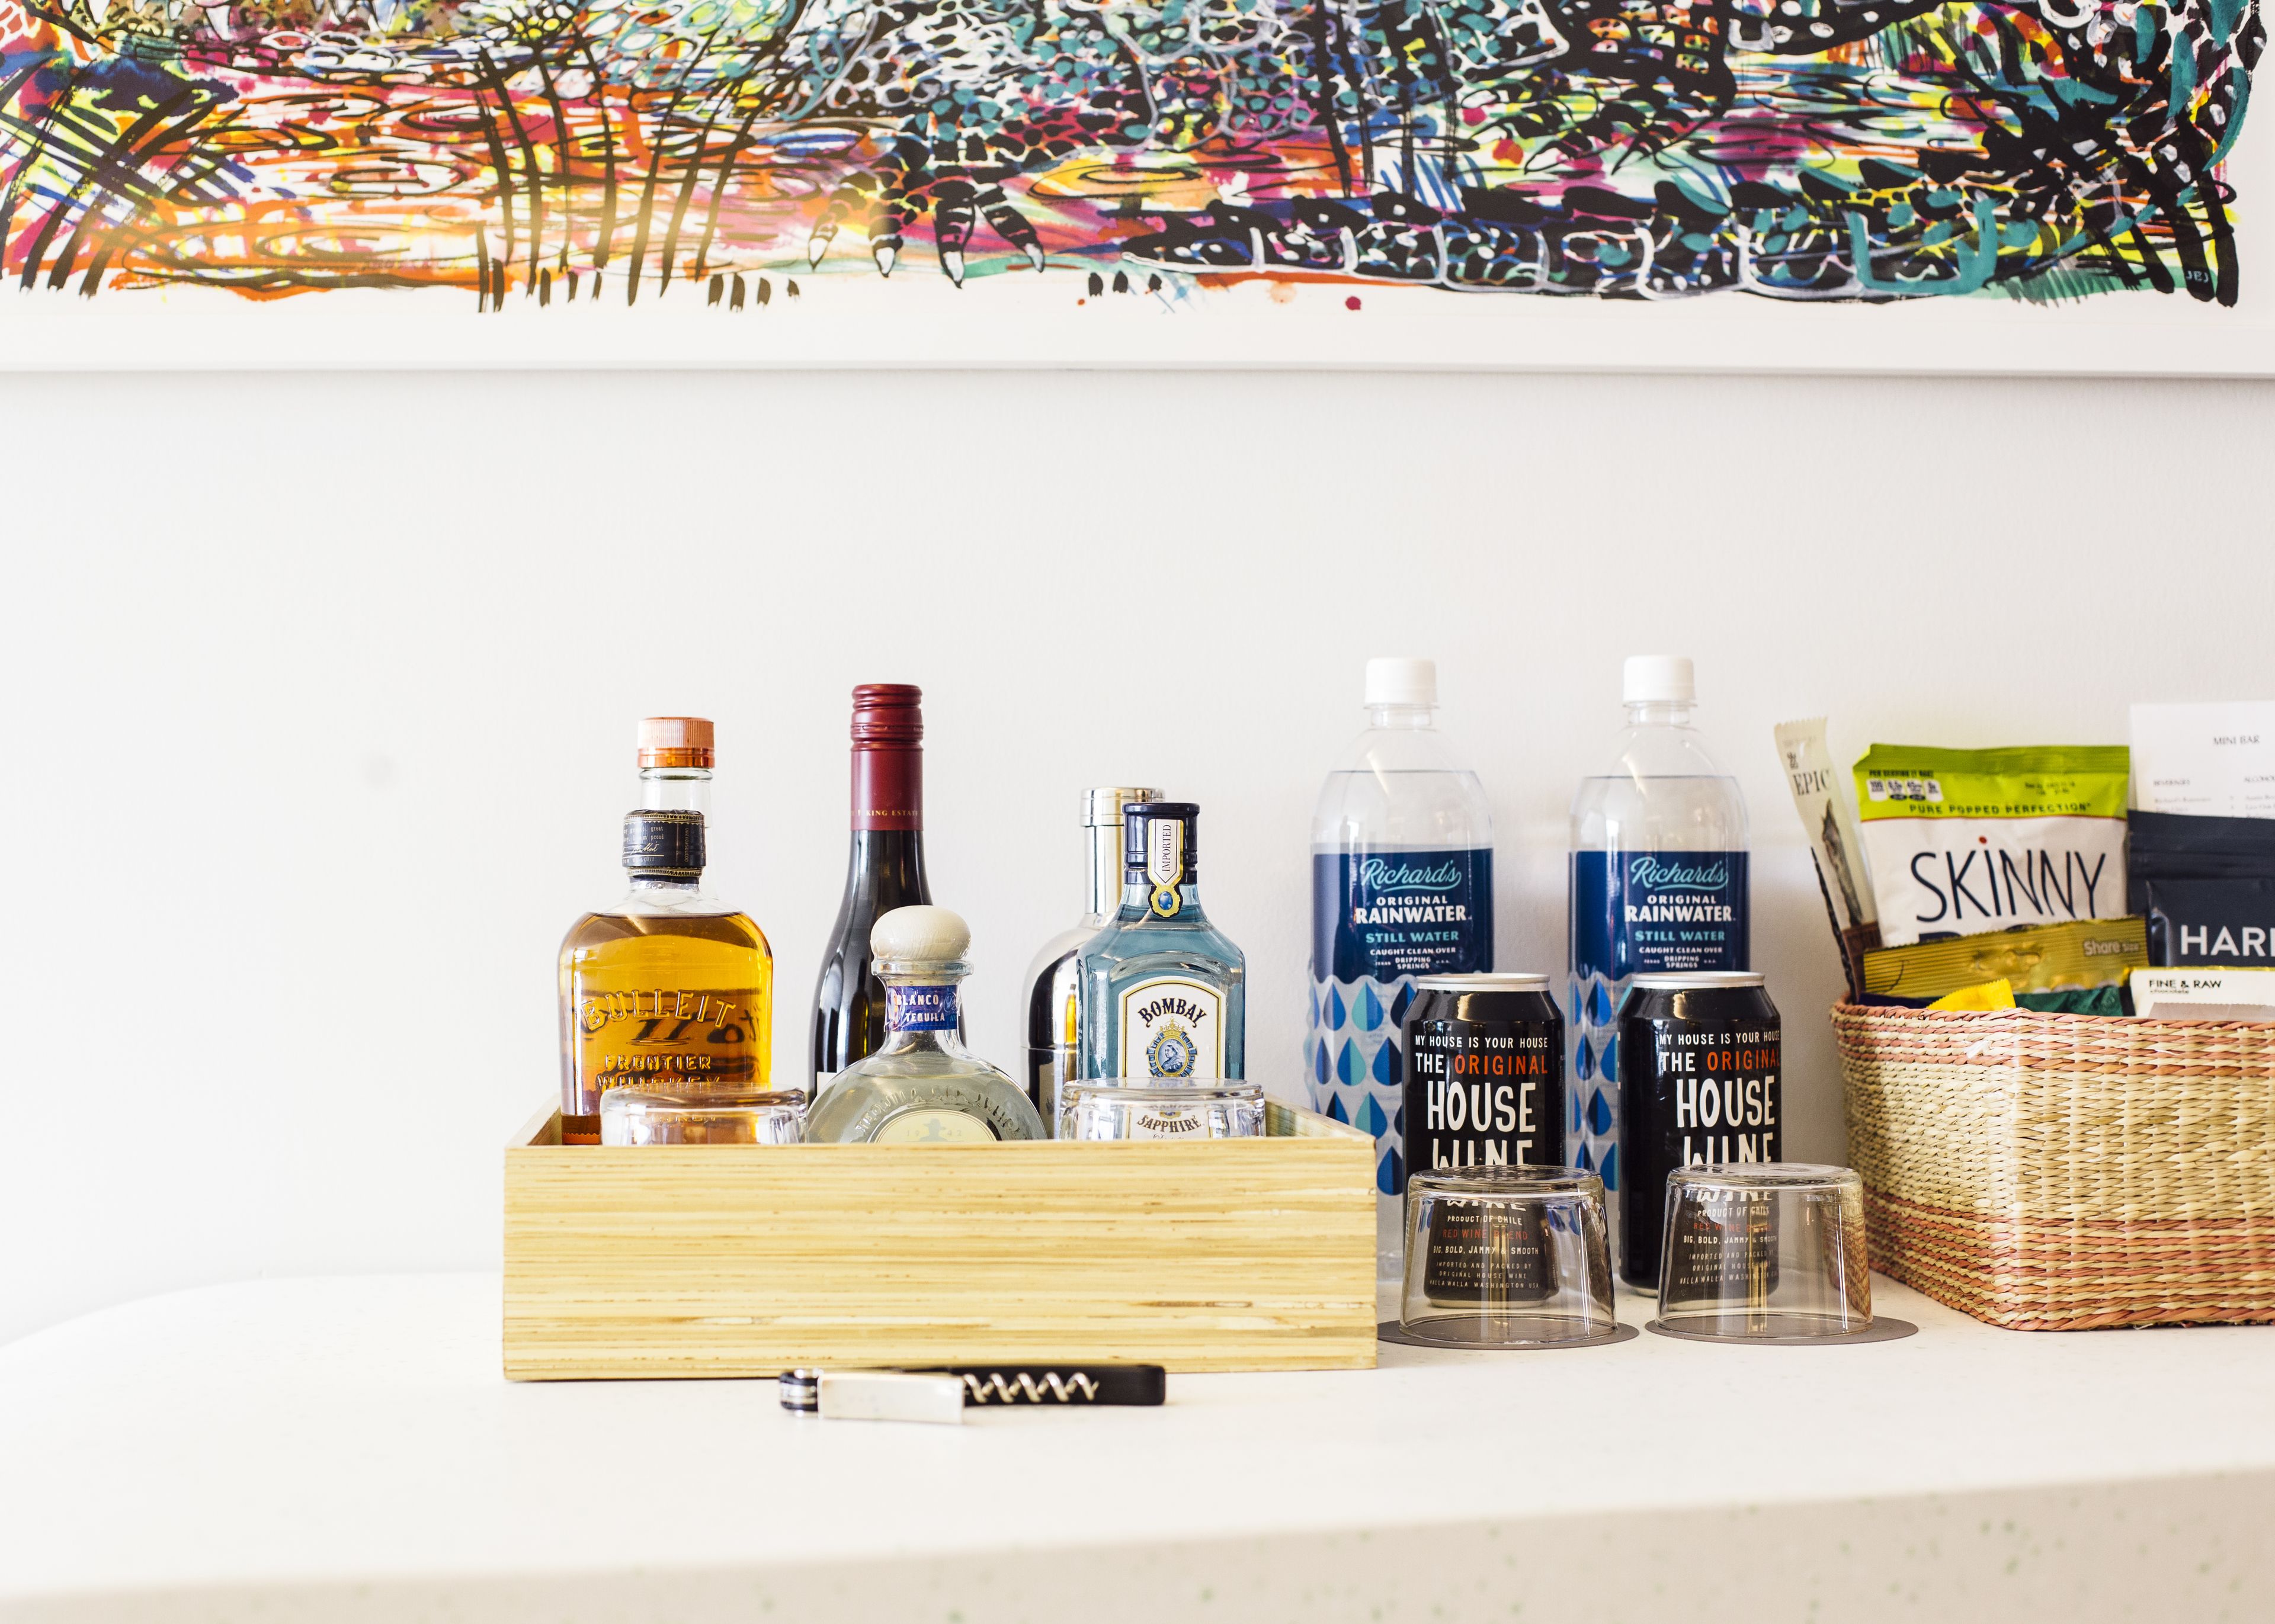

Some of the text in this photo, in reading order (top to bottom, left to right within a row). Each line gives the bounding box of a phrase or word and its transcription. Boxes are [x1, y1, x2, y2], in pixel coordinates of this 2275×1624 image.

[2214, 735, 2260, 745] MINI BAR
[1793, 768, 1831, 795] EPIC
[1909, 804, 1942, 814] PURE
[1949, 804, 2000, 814] POPPED
[1162, 824, 1171, 872] IMPORTED
[1360, 859, 1462, 892] Richard's
[1630, 856, 1728, 891] Richard's
[1376, 895, 1447, 906] ORIGINAL
[1647, 895, 1716, 904] ORIGINAL
[1355, 905, 1467, 924] RAINWATER
[1624, 905, 1732, 922] RAINWATER
[1366, 930, 1459, 943] STILL WATER
[1635, 930, 1725, 942] STILL WATER
[2084, 940, 2120, 956] Share
[896, 994, 938, 1006] BLANCO
[581, 988, 736, 1031] BULLEIT
[1138, 998, 1207, 1028] BOMBAY
[905, 1013, 945, 1022] TEQUILA
[1415, 1035, 1547, 1048] MY HOUSE IS YOUR HOUSE
[1659, 1034, 1672, 1045] MY
[1678, 1034, 1715, 1045] HOUSE
[1720, 1033, 1731, 1044] IS
[1736, 1032, 1760, 1044] YOUR
[605, 1054, 712, 1071] FRONTIER
[1415, 1052, 1548, 1075] THE ORIGINAL
[1660, 1052, 1696, 1071] THE
[1428, 1080, 1536, 1132] HOUSE
[1677, 1076, 1775, 1128] HOUSE
[1137, 1115, 1202, 1133] SAPPHIRE
[1684, 1132, 1773, 1167] WINE
[1697, 1207, 1733, 1218] PRODUCT
[1736, 1206, 1747, 1217] OF
[1498, 1215, 1523, 1225] CHILE
[1443, 1228, 1457, 1238] RED
[1462, 1229, 1488, 1239] WINE
[1469, 1246, 1496, 1254] JAMMY
[1689, 1252, 1722, 1260] IMPORTED
[1693, 1263, 1726, 1272] ORIGINAL
[1701, 1275, 1723, 1283] WALLA
